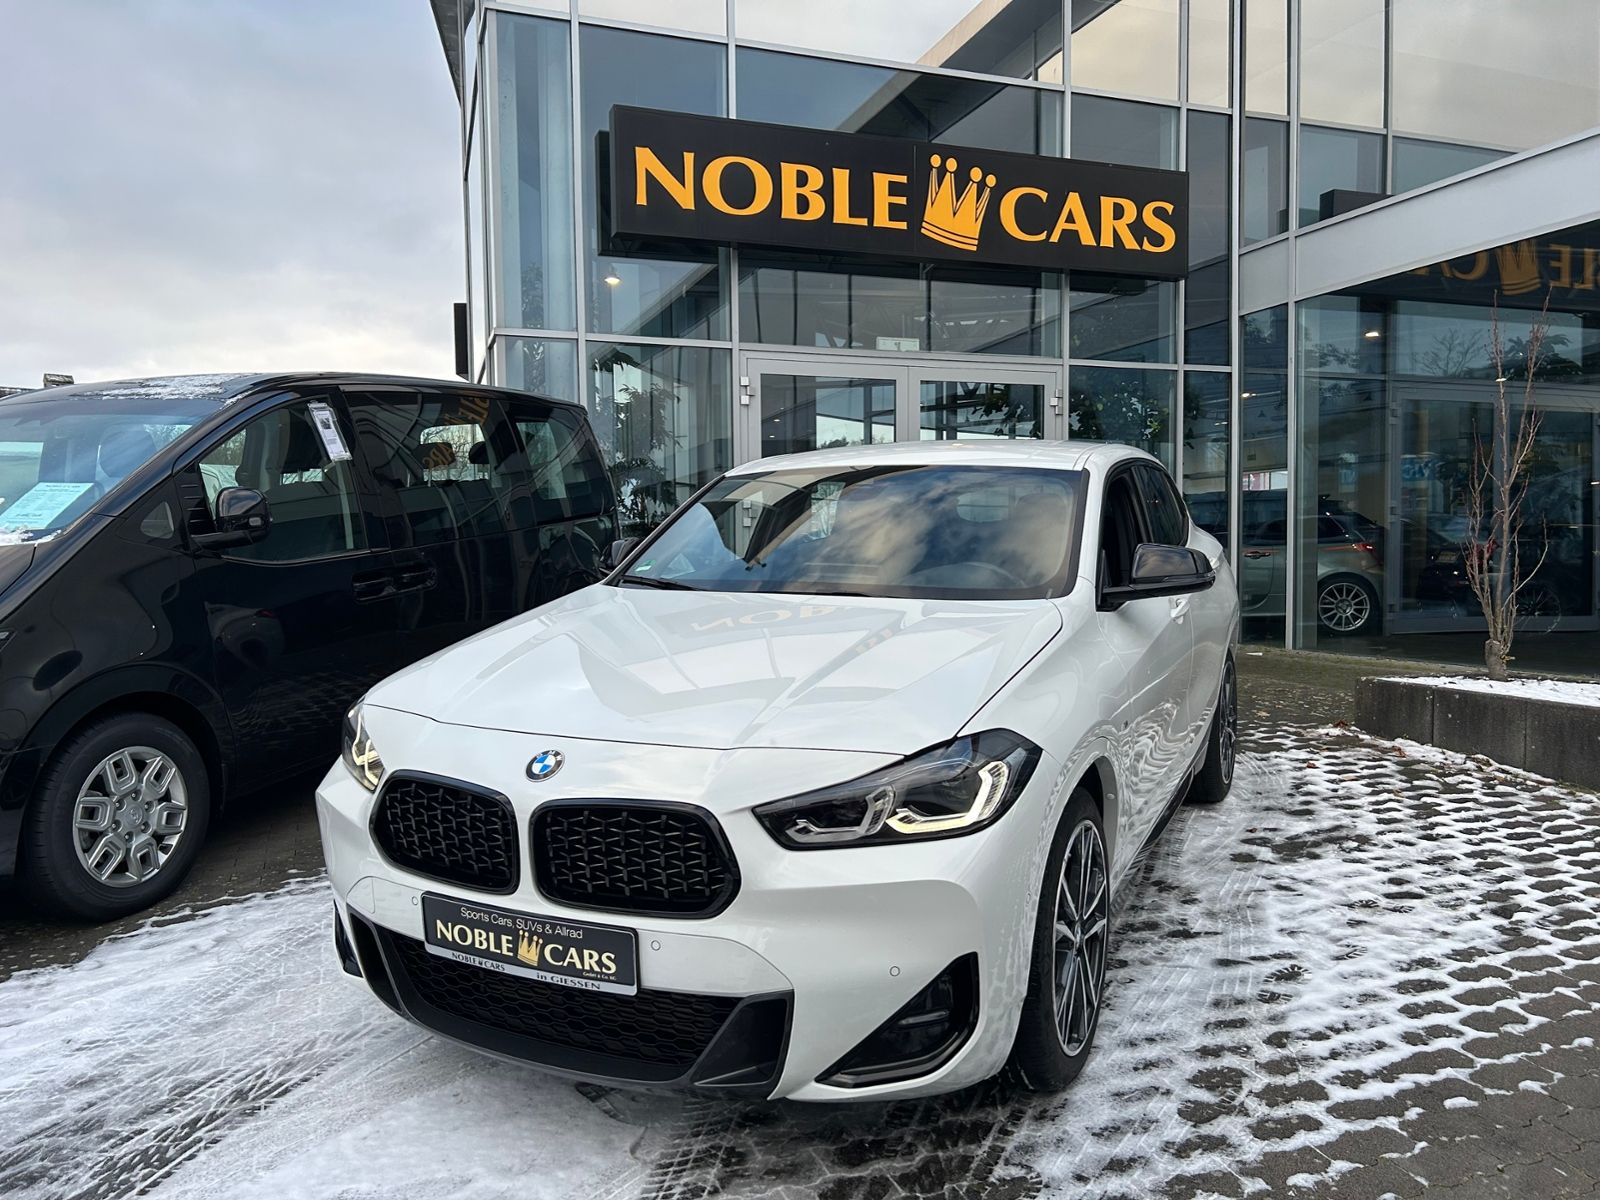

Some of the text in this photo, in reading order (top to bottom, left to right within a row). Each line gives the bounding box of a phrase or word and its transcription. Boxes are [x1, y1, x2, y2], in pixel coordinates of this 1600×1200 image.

[634, 146, 1177, 253] NOBLE CARS
[460, 907, 583, 939] Sports Cars, SUVs & Allrad
[436, 919, 617, 974] NOBLE CARS
[452, 952, 506, 971] NOBLE CARS
[536, 972, 601, 990] in GIESSEN
